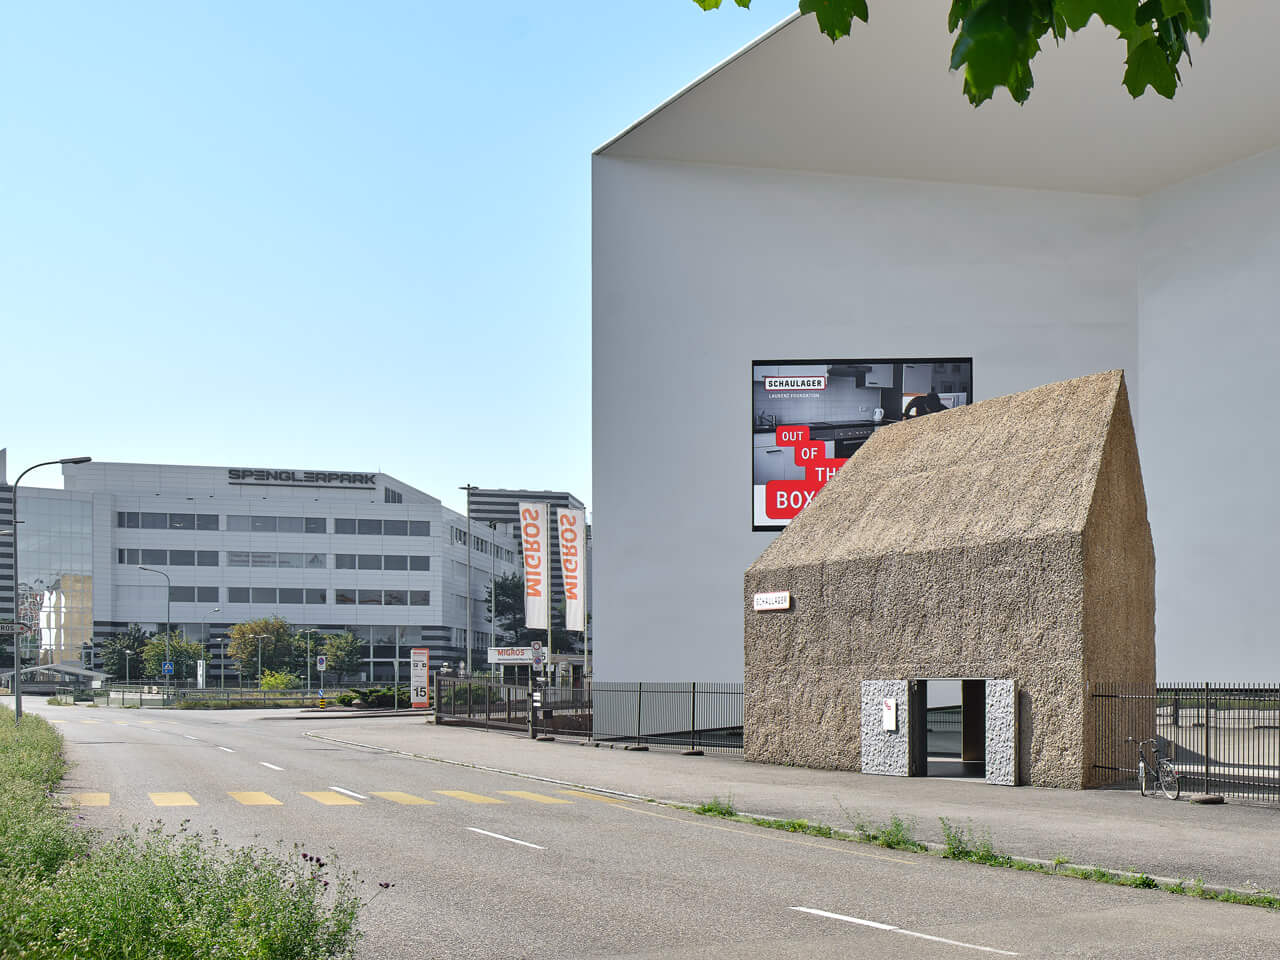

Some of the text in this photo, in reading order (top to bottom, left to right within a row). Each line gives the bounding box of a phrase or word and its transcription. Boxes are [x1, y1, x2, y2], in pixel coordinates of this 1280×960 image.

[768, 379, 822, 387] SCHAULAGER
[782, 431, 803, 441] OUT
[801, 447, 818, 459] OF
[228, 468, 376, 485] SPENGLERPARK
[815, 467, 837, 482] TH
[776, 490, 815, 509] BOX
[497, 649, 525, 657] MIGROS
[413, 687, 427, 698] 15
